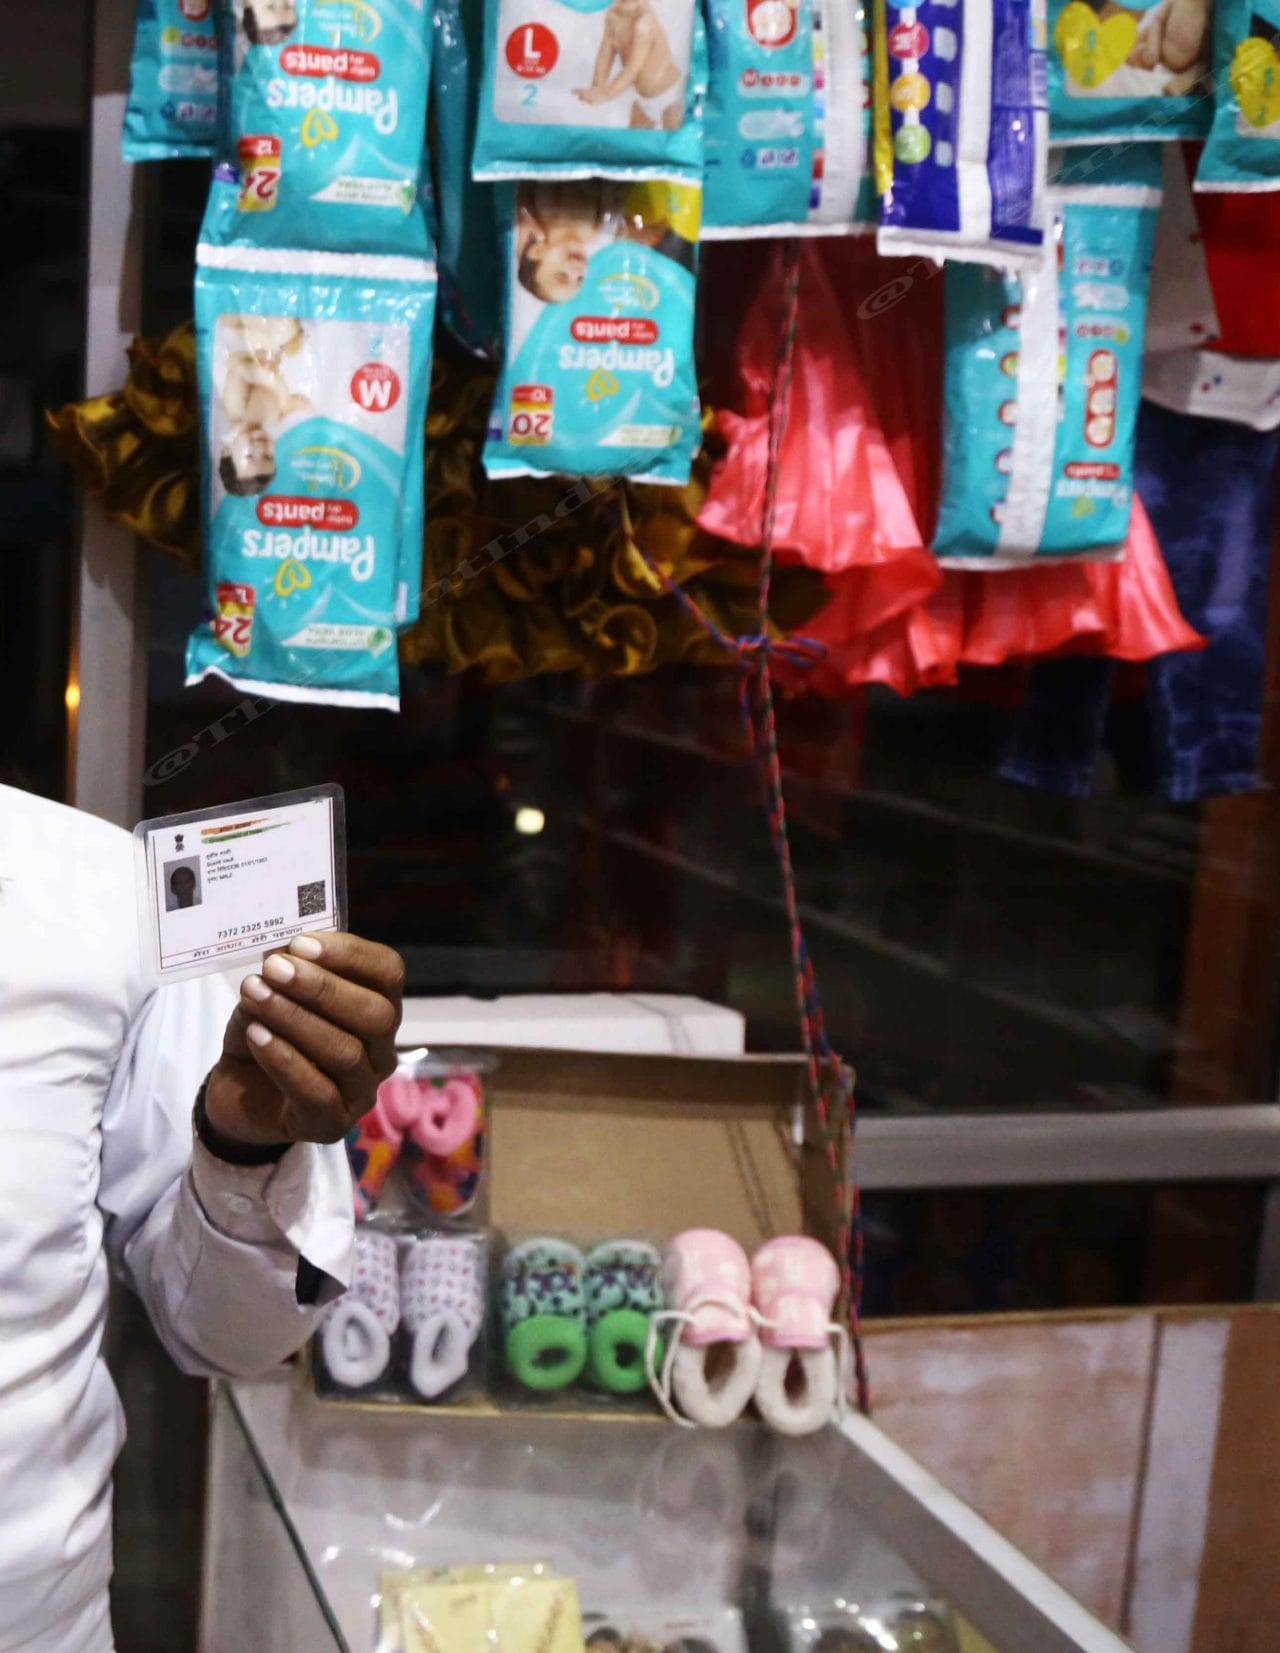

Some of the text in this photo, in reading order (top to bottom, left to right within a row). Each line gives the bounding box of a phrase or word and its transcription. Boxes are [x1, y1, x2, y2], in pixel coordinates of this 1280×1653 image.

[524, 27, 542, 59] L
[286, 50, 349, 73] pants
[266, 76, 399, 135] Pampers
[522, 83, 539, 105] 2
[255, 139, 274, 154] 12
[574, 320, 631, 339] pants
[559, 341, 675, 388] Pampers
[510, 413, 551, 437] 20
[262, 501, 326, 520] pants
[241, 526, 376, 582] Pampers
[212, 618, 252, 645] 24
[217, 917, 284, 940] 7372 2325 5992
